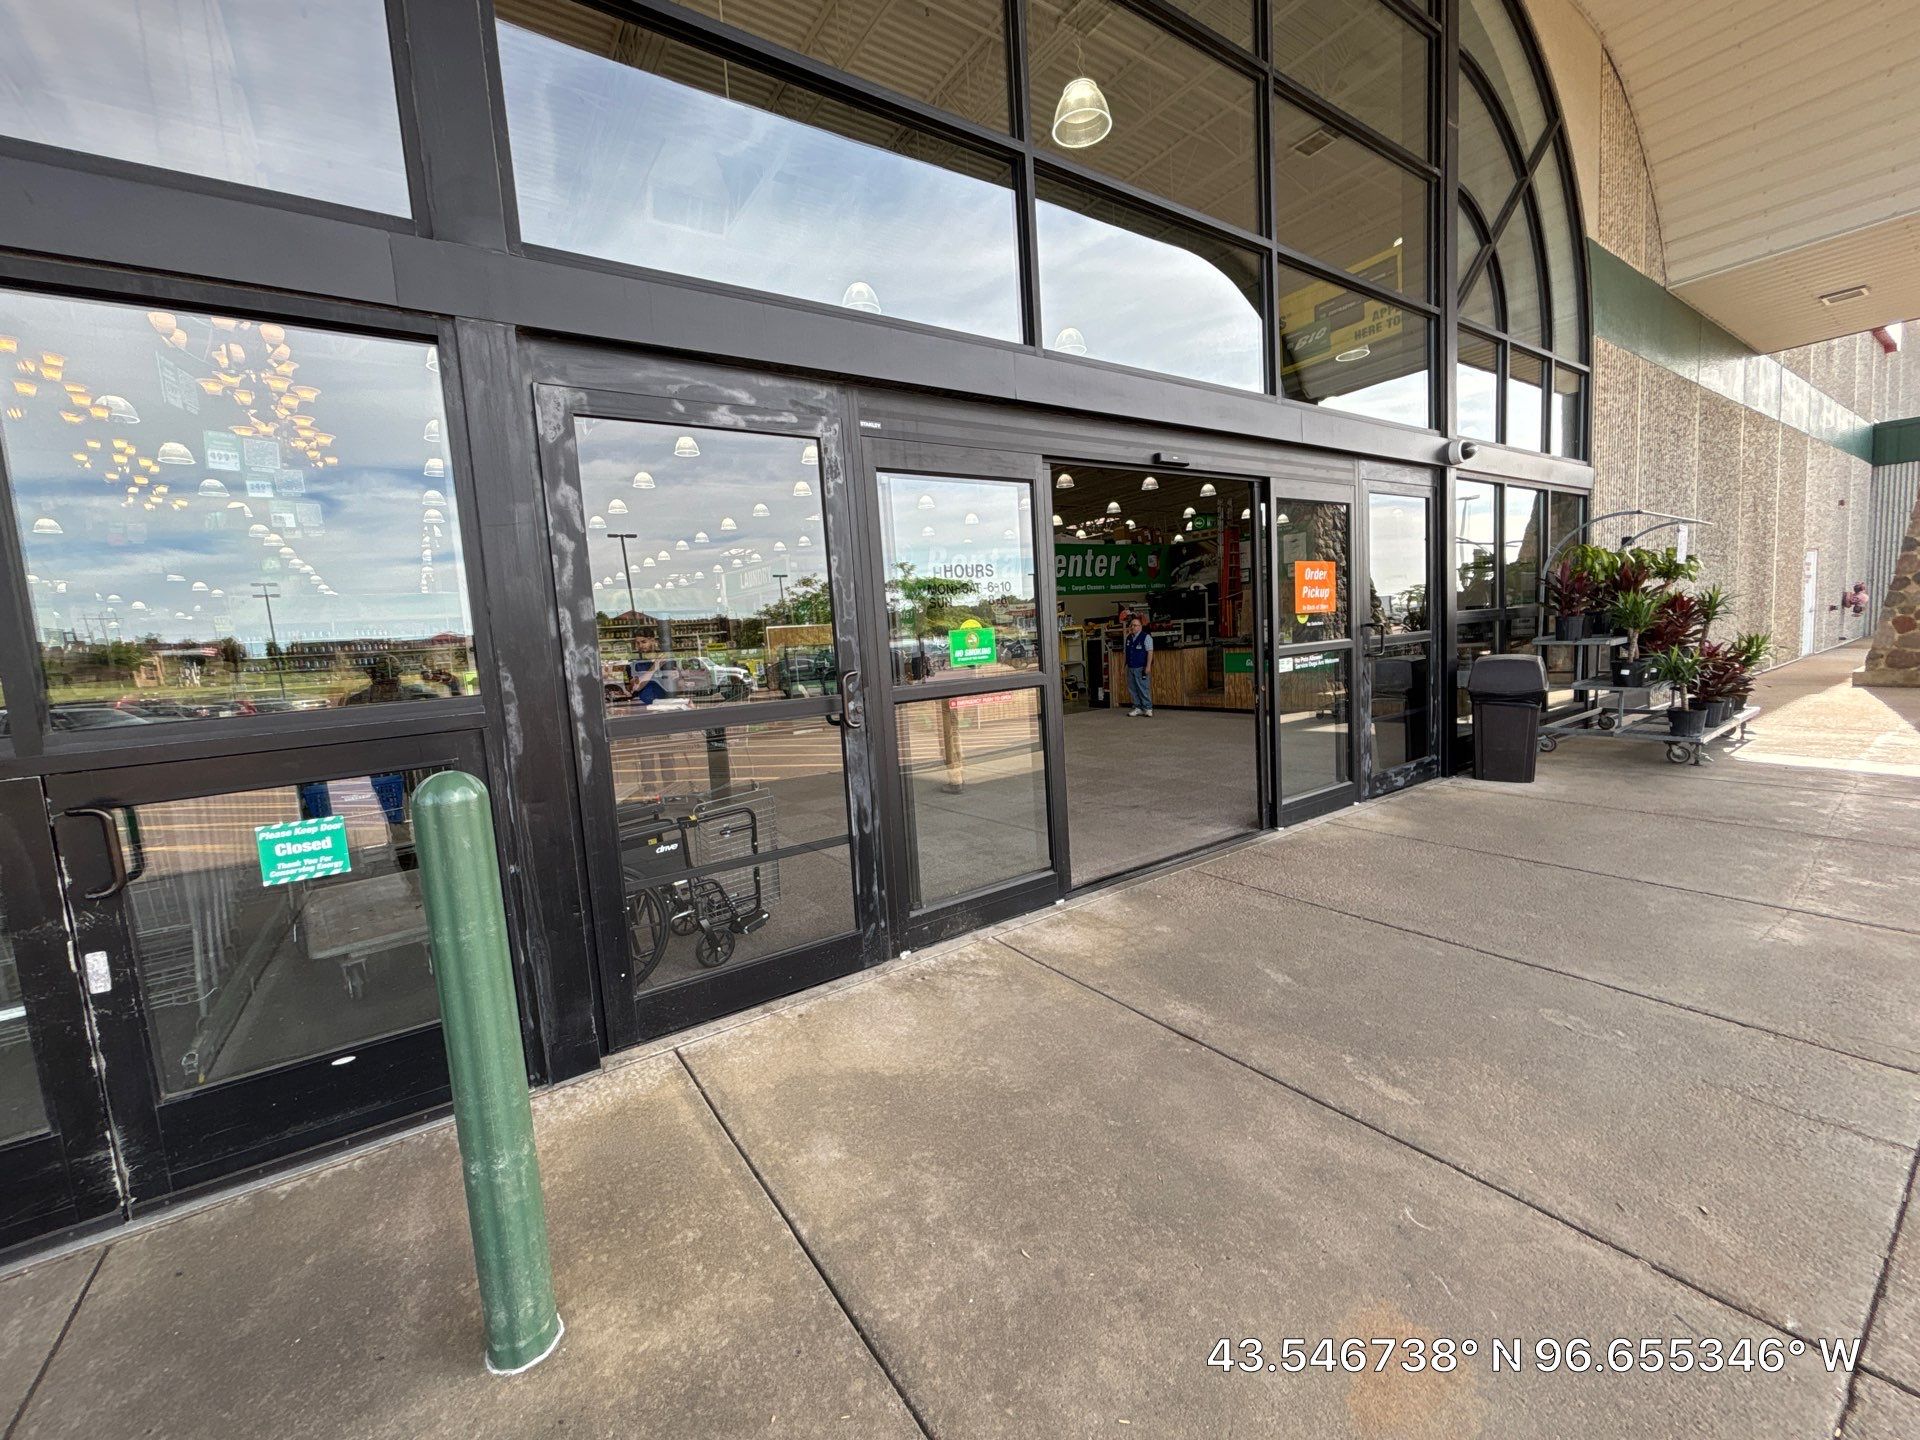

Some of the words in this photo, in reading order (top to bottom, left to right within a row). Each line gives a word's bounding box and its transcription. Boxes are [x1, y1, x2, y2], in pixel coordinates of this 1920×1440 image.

[1055, 548, 1120, 578] enter
[943, 563, 994, 578] HOURS
[1305, 567, 1328, 580] Order
[1302, 585, 1330, 599] Pickup
[928, 597, 953, 609] SUN
[259, 829, 293, 841] Please
[294, 826, 319, 836] Keep
[320, 822, 343, 831] Door
[274, 836, 333, 857] Closed
[656, 843, 678, 853] drive
[276, 860, 302, 870] Thank
[303, 858, 318, 866] You
[319, 855, 334, 863] For
[317, 860, 344, 870] Energy
